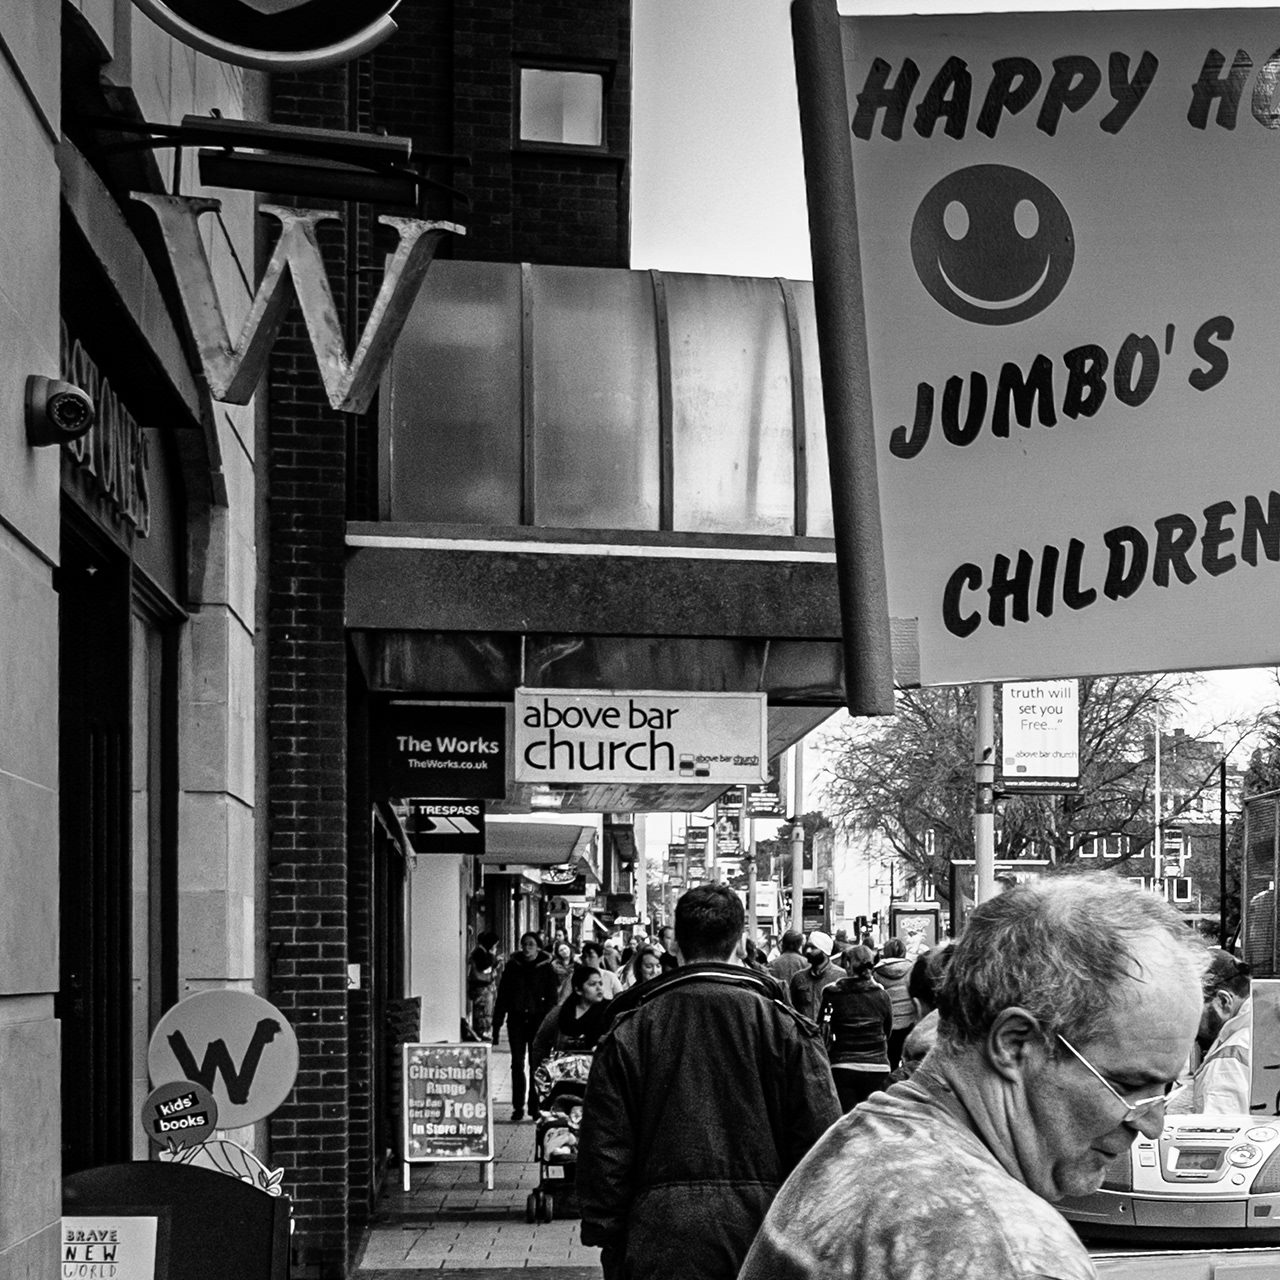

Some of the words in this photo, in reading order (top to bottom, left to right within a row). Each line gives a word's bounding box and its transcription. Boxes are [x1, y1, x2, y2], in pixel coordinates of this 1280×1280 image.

[853, 50, 1159, 143] HAPPY
[130, 191, 467, 415] W
[888, 315, 1235, 460] JUMBO'S
[1010, 686, 1045, 699] truth
[1048, 687, 1072, 699] will
[523, 698, 621, 729] above
[629, 699, 680, 730] bar
[1018, 704, 1037, 715] set
[1039, 705, 1063, 718] you
[397, 735, 432, 753] The
[436, 736, 500, 754] Works
[523, 729, 675, 772] church
[408, 758, 489, 770] TheWorks.co.uk
[418, 804, 481, 816] TRESPASS
[167, 1018, 283, 1105] W
[409, 1065, 484, 1080] Christmas
[426, 1081, 467, 1096] Range
[444, 1099, 487, 1119] Free
[159, 1112, 206, 1132] books
[412, 1123, 425, 1135] In
[425, 1123, 457, 1135] Store
[459, 1123, 484, 1135] Now
[66, 1229, 118, 1242] BRAVE
[62, 1264, 117, 1279] WORLD
